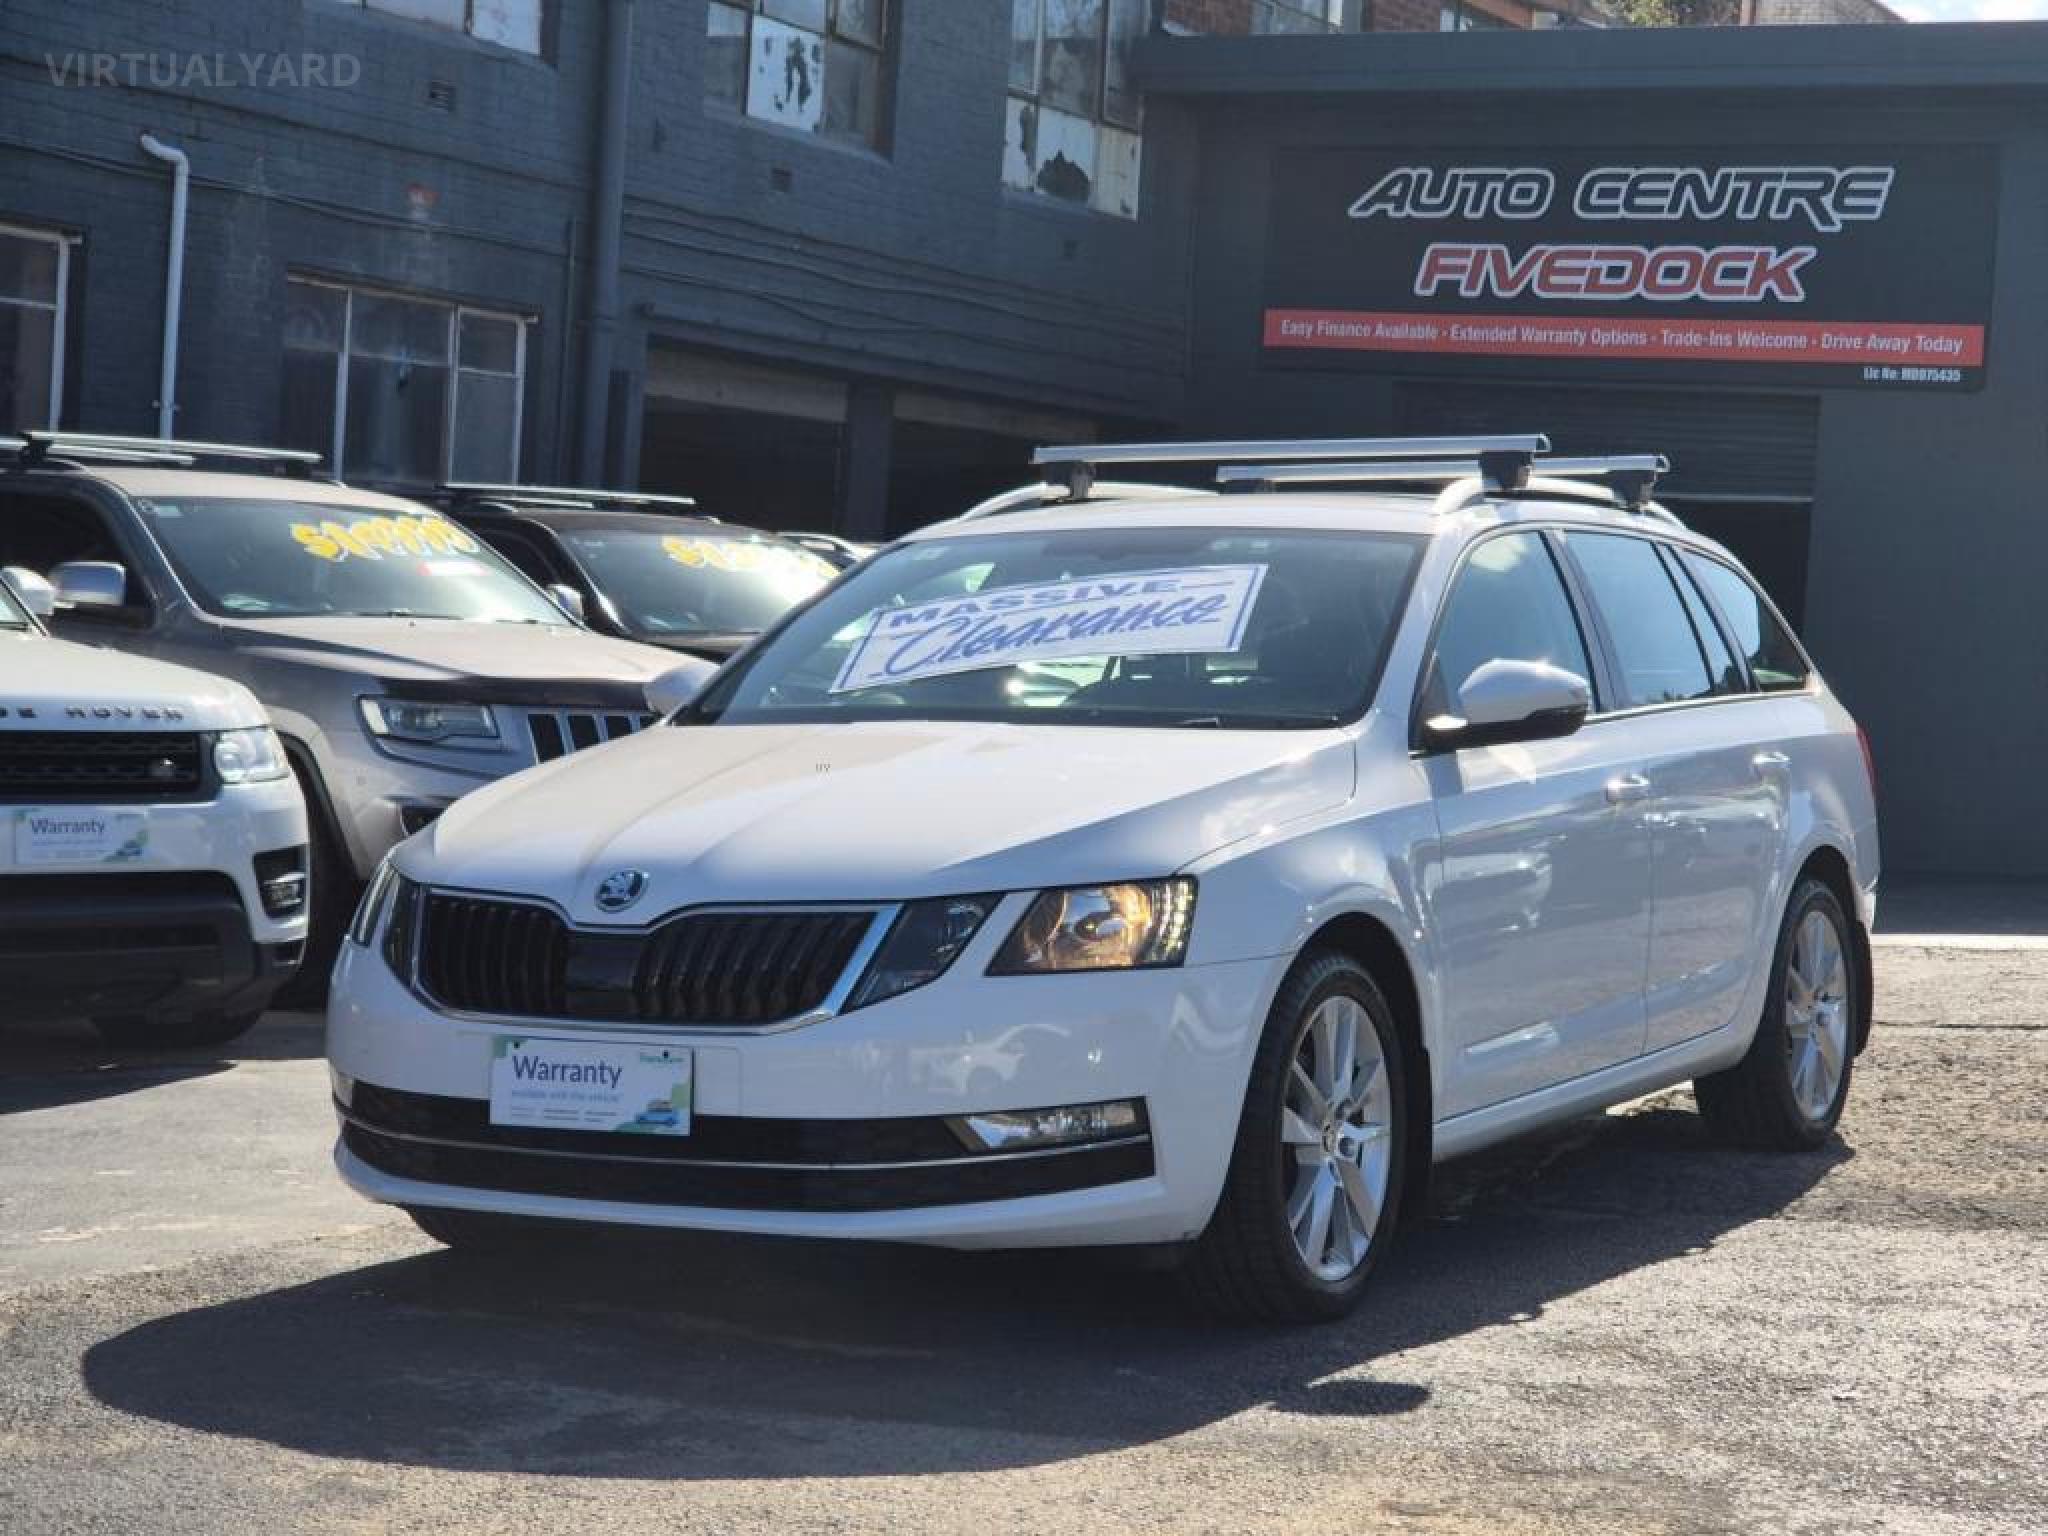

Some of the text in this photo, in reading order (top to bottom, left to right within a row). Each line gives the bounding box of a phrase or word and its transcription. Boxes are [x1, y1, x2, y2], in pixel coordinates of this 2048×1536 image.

[1347, 166, 1895, 233] AUTO CENTRE
[1413, 242, 1817, 303] FIVEDOCK
[1280, 319, 1313, 338] Easy
[1317, 320, 1371, 337] Finance
[1375, 322, 1440, 340] Available
[1450, 324, 1517, 342] Extended
[1521, 327, 1587, 347] Warranty
[1591, 328, 1647, 348] Options
[1662, 328, 1732, 347] Trade-Ins
[1737, 329, 1808, 349] Welcome
[1822, 333, 1862, 349] Drive
[1867, 334, 1911, 354] Away
[1916, 335, 1963, 356] Today
[889, 579, 1182, 628] MASSIVE
[884, 593, 1227, 675] Clearance
[31, 817, 104, 835] Warranty
[511, 1055, 623, 1088] Warranty
